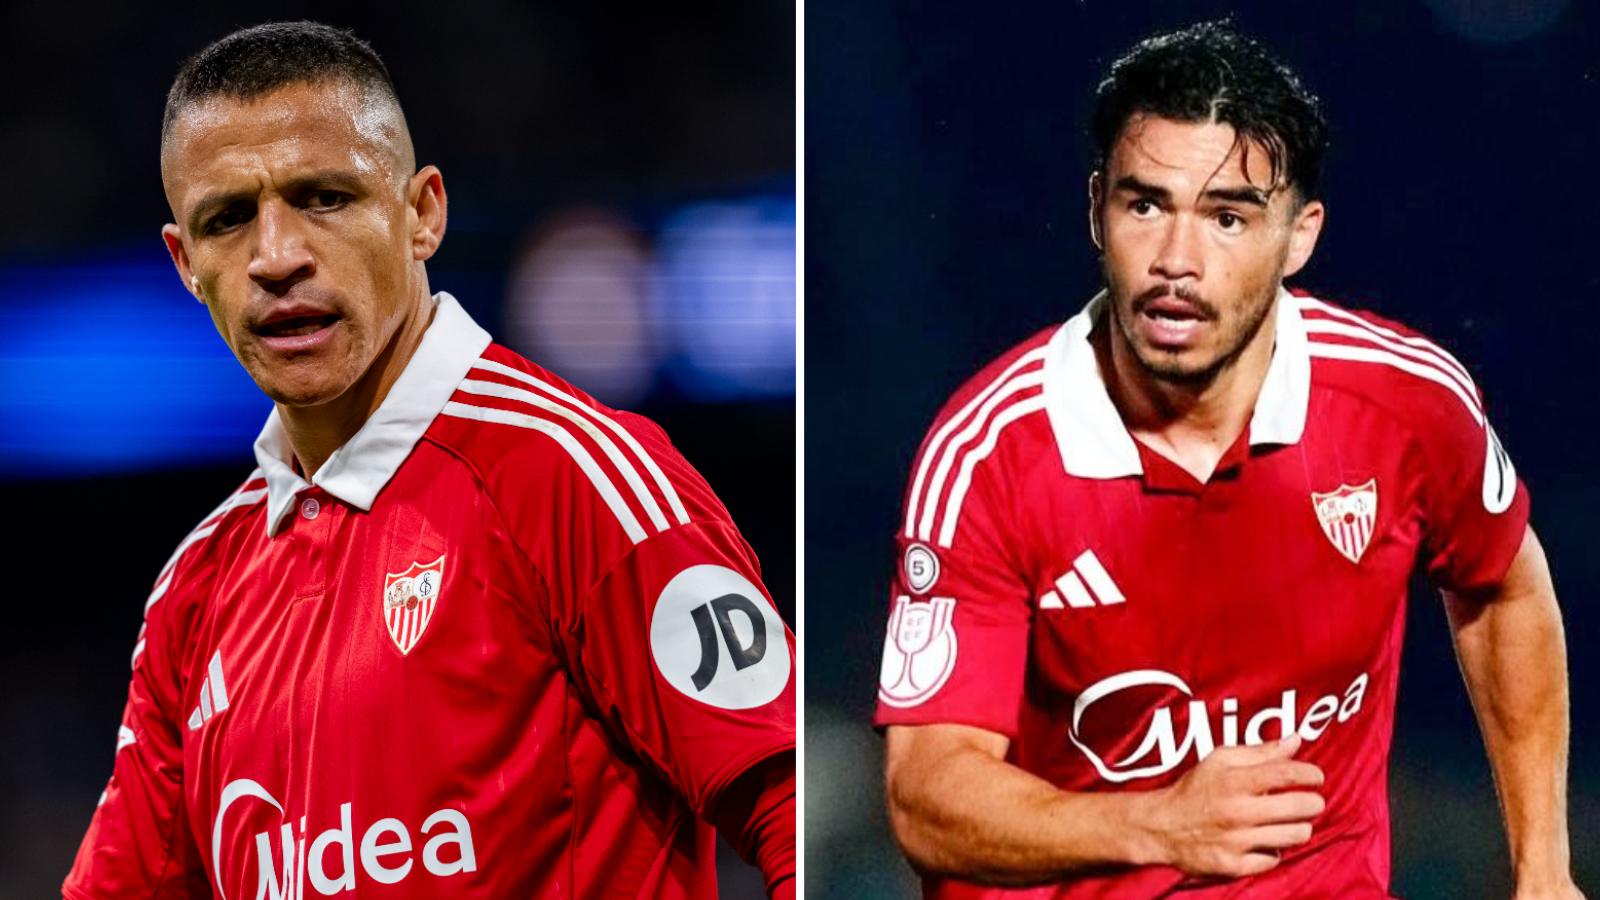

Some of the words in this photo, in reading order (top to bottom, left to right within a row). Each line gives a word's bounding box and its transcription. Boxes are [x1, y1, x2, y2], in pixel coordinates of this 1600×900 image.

[913, 561, 925, 576] 5
[690, 593, 767, 692] JD
[1112, 672, 1369, 766] Midea
[253, 802, 477, 900] Midea
